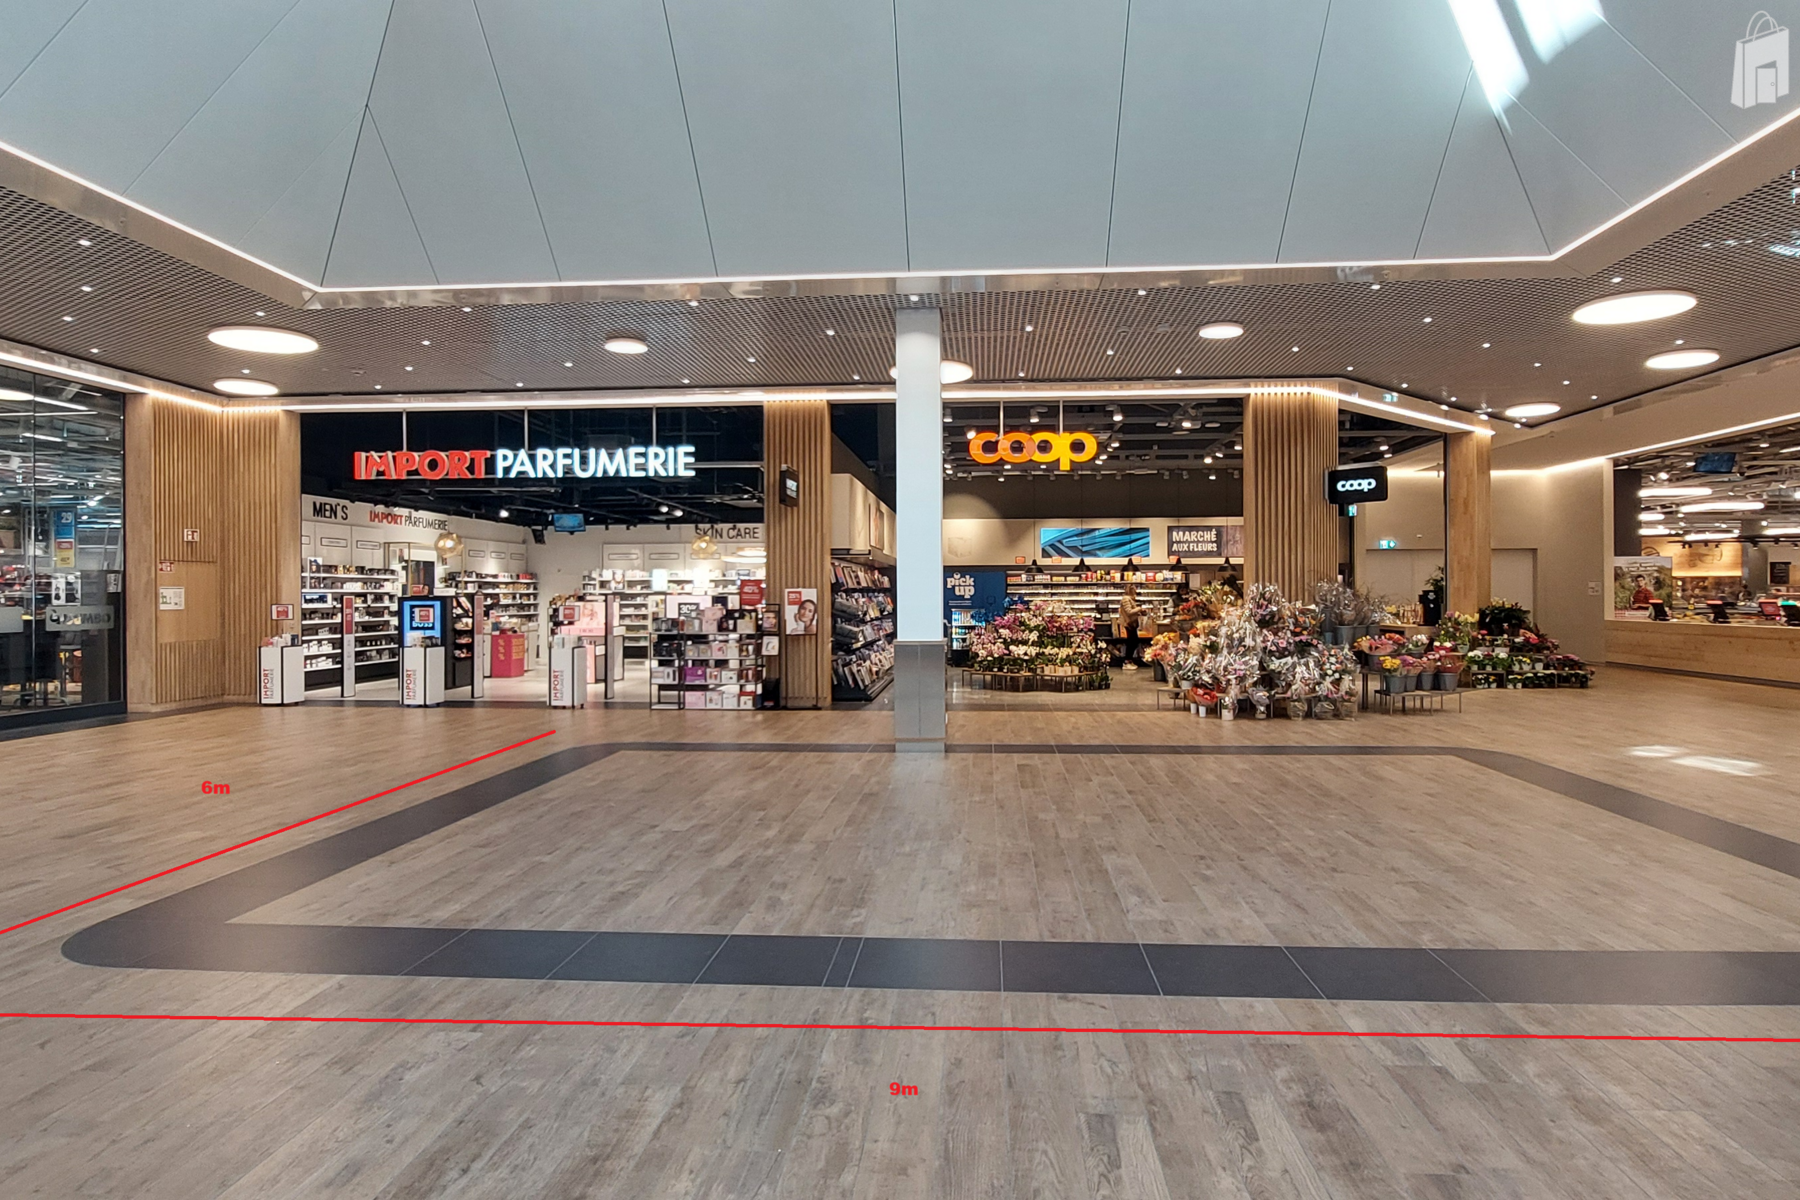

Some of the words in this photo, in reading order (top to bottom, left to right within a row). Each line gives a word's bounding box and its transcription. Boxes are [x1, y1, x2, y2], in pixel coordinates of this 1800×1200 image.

[969, 432, 1098, 471] coop
[354, 450, 490, 480] IMPORT
[496, 446, 696, 479] PARFUMERIE
[1337, 478, 1377, 492] coop
[369, 510, 403, 525] IMPORT
[404, 515, 448, 531] PARFUMERIE
[727, 526, 760, 540] CARE
[1172, 528, 1217, 542] MARCHÉ
[1172, 543, 1189, 552] AUX
[1189, 543, 1217, 552] FLEURS
[946, 572, 975, 588] pick
[954, 586, 975, 599] up
